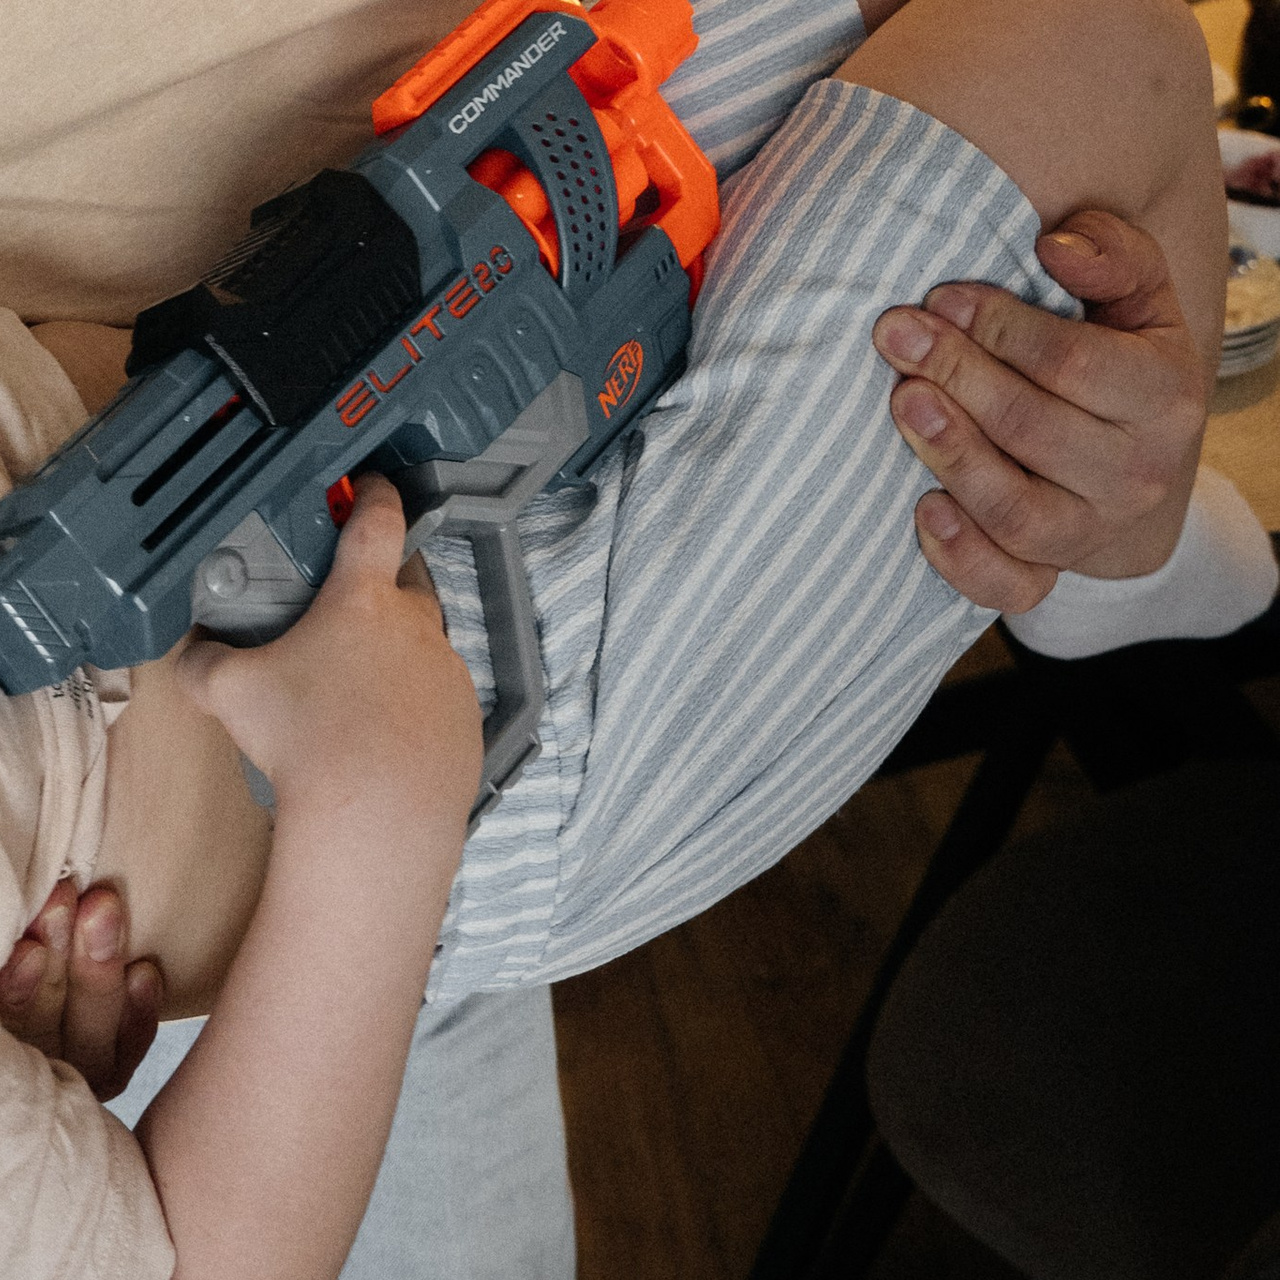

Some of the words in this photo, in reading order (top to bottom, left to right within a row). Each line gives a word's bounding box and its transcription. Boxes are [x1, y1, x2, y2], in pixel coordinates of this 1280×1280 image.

[447, 20, 568, 136] COMMANDER
[334, 276, 480, 428] ELITE
[597, 338, 643, 419] NERF
